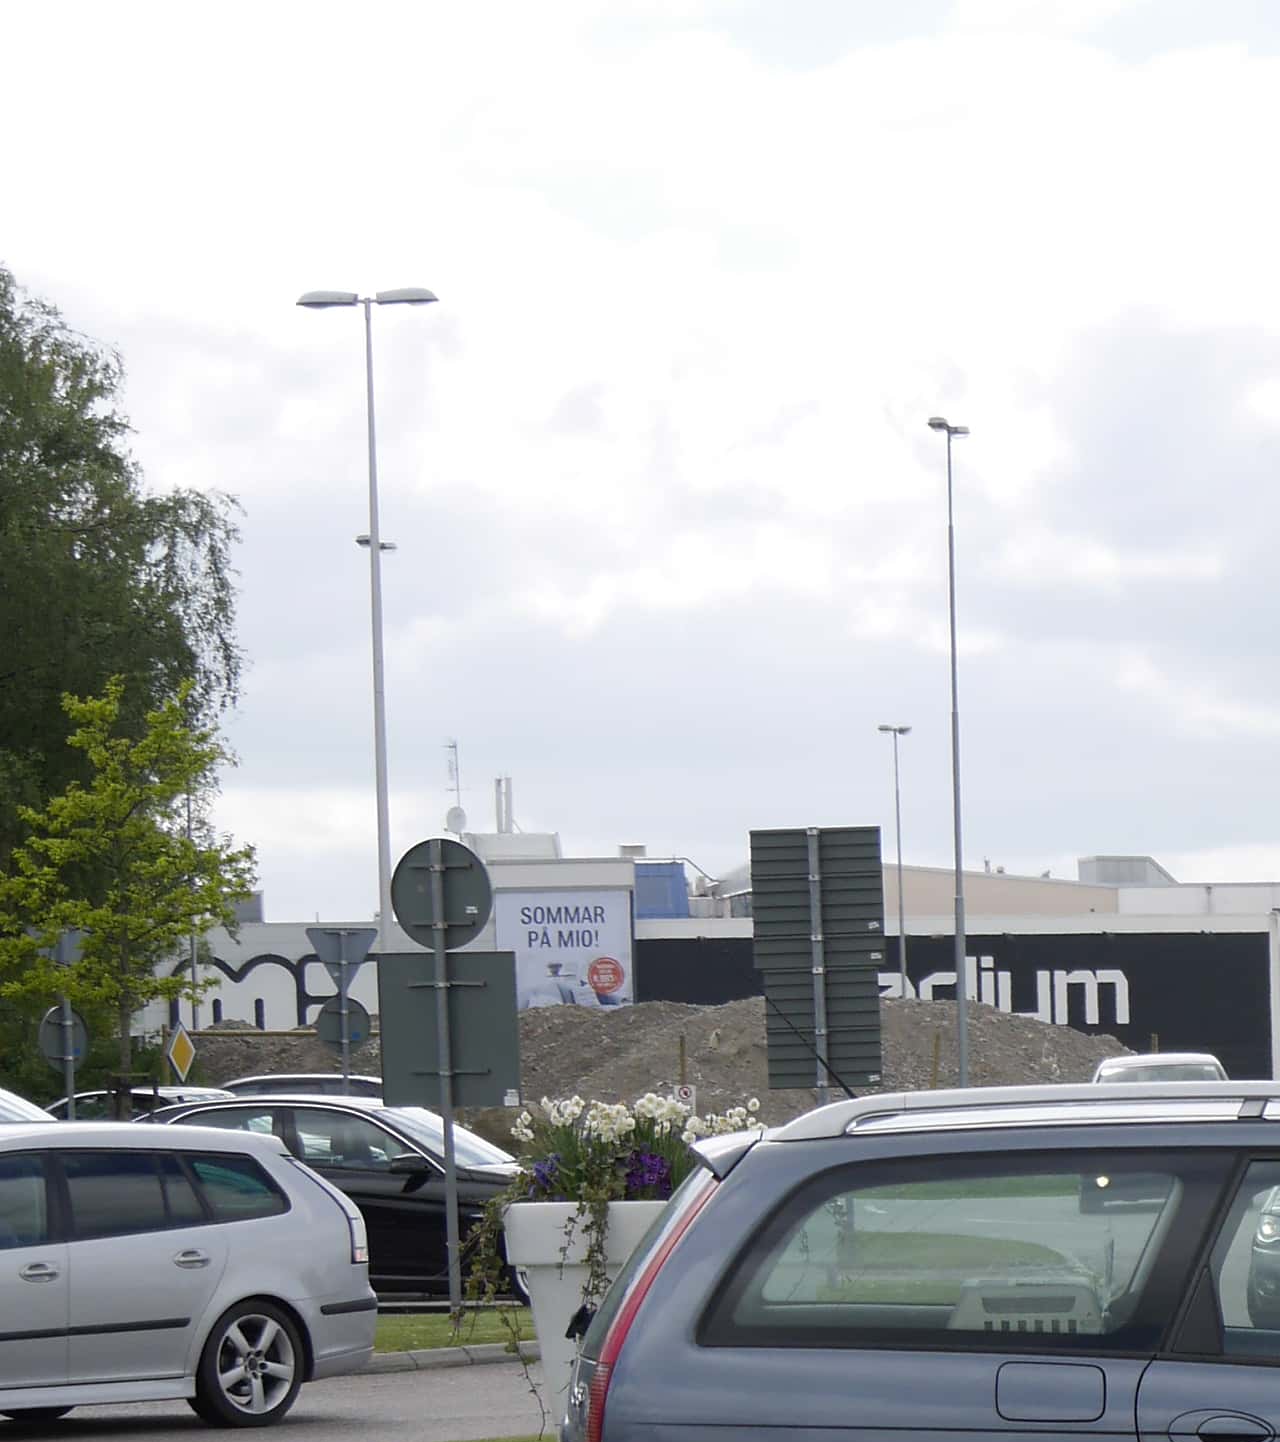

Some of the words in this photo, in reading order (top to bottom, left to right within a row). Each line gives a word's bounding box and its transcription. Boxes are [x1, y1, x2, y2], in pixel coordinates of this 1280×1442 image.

[520, 905, 605, 925] SOMMAR
[527, 926, 552, 948] PÅ
[557, 929, 600, 948] MIO!
